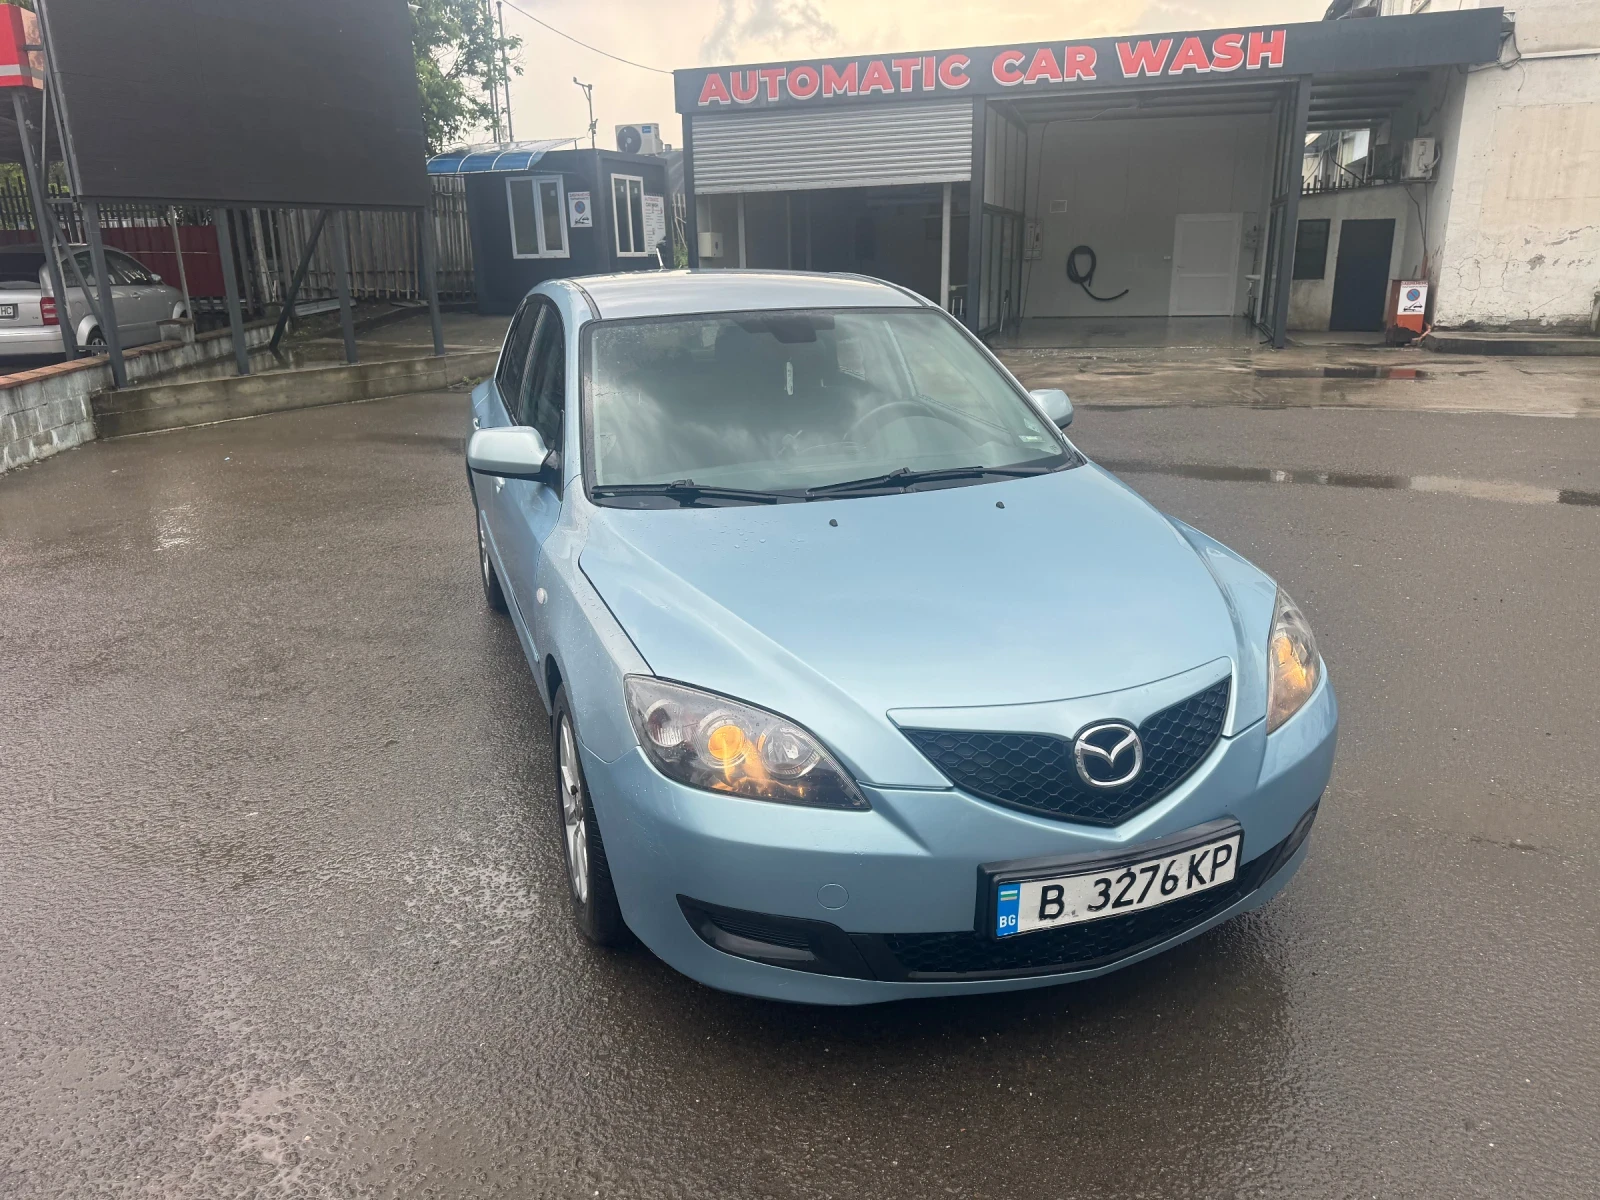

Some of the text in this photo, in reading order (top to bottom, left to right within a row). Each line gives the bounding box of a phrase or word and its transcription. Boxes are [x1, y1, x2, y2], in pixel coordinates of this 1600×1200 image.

[698, 29, 1286, 106] AUTOMATIC CAR WASH
[1, 306, 12, 315] HC
[1038, 843, 1233, 921] B 3276 KP
[999, 914, 1016, 928] BG
